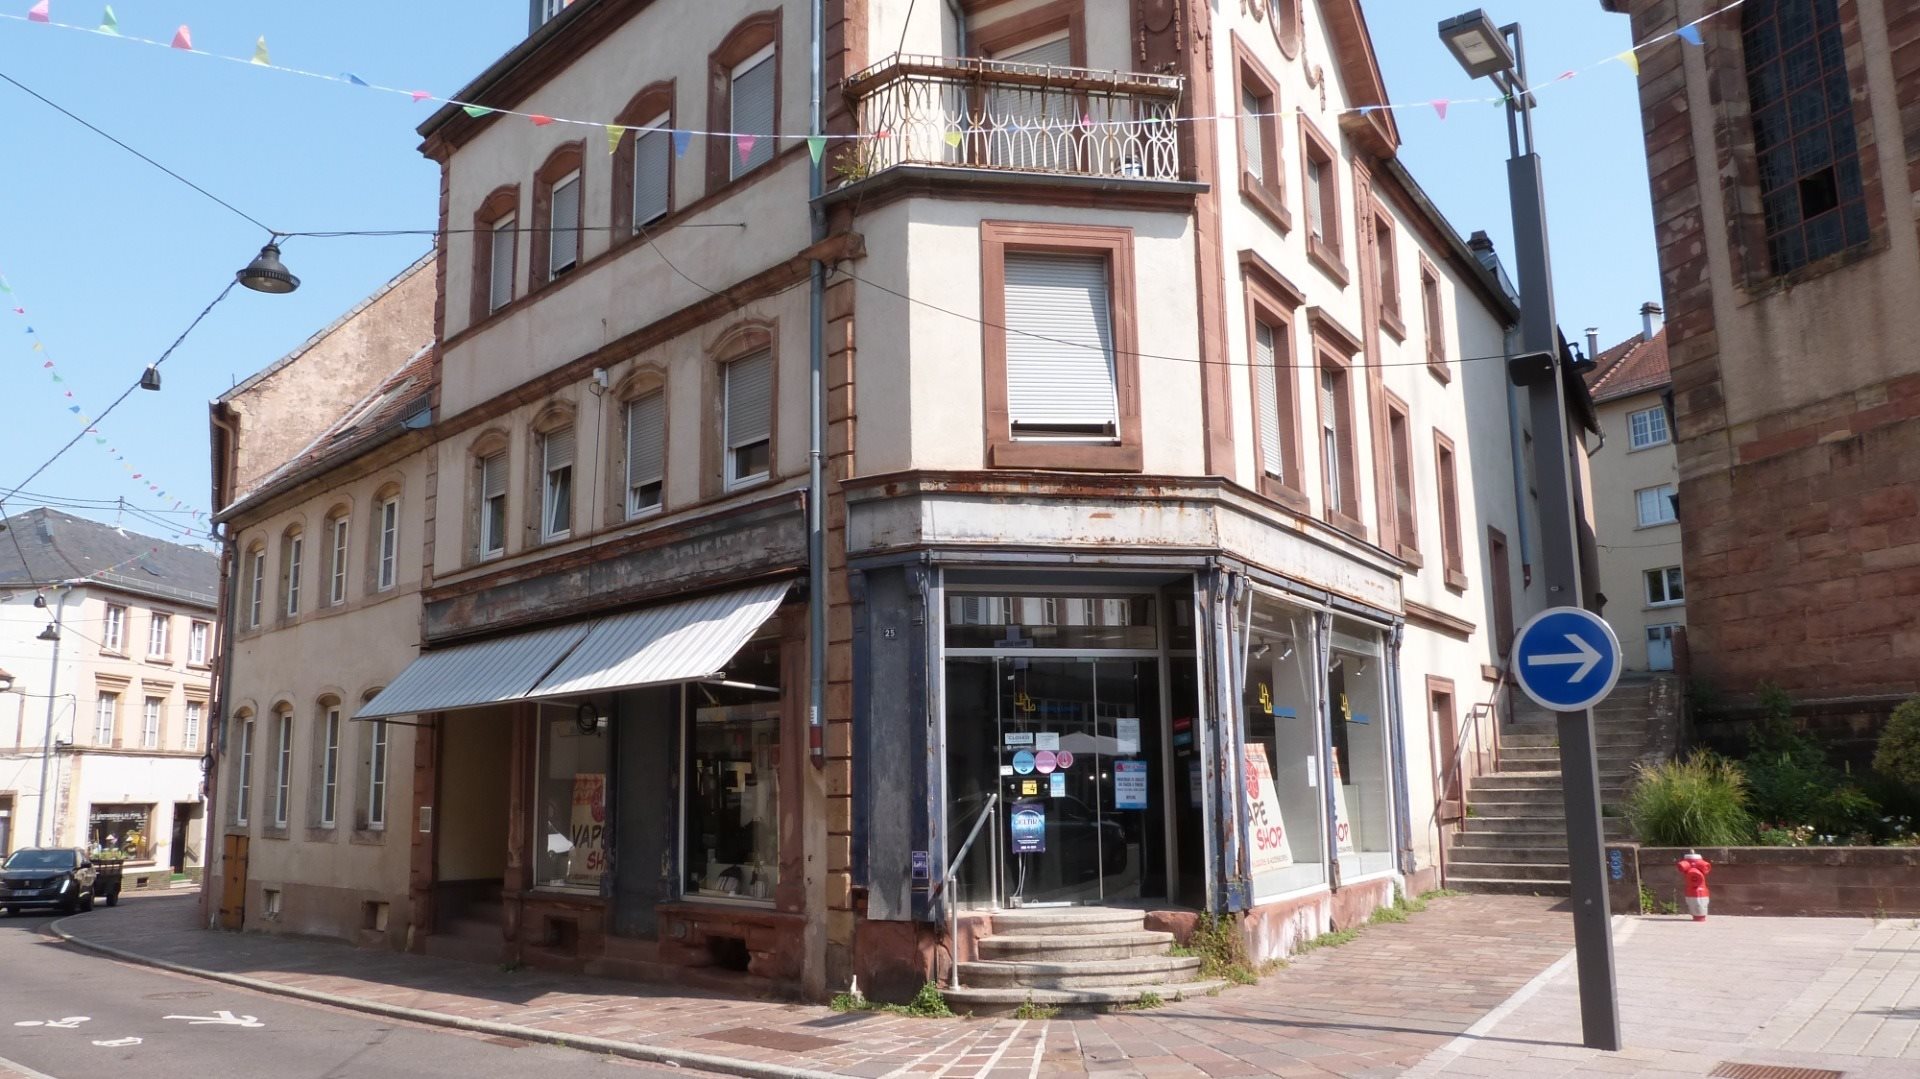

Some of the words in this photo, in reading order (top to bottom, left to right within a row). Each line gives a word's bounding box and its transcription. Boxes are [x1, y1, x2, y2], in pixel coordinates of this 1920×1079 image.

[885, 629, 895, 637] 25
[1248, 802, 1268, 826] APE
[1256, 826, 1281, 850] SHOP
